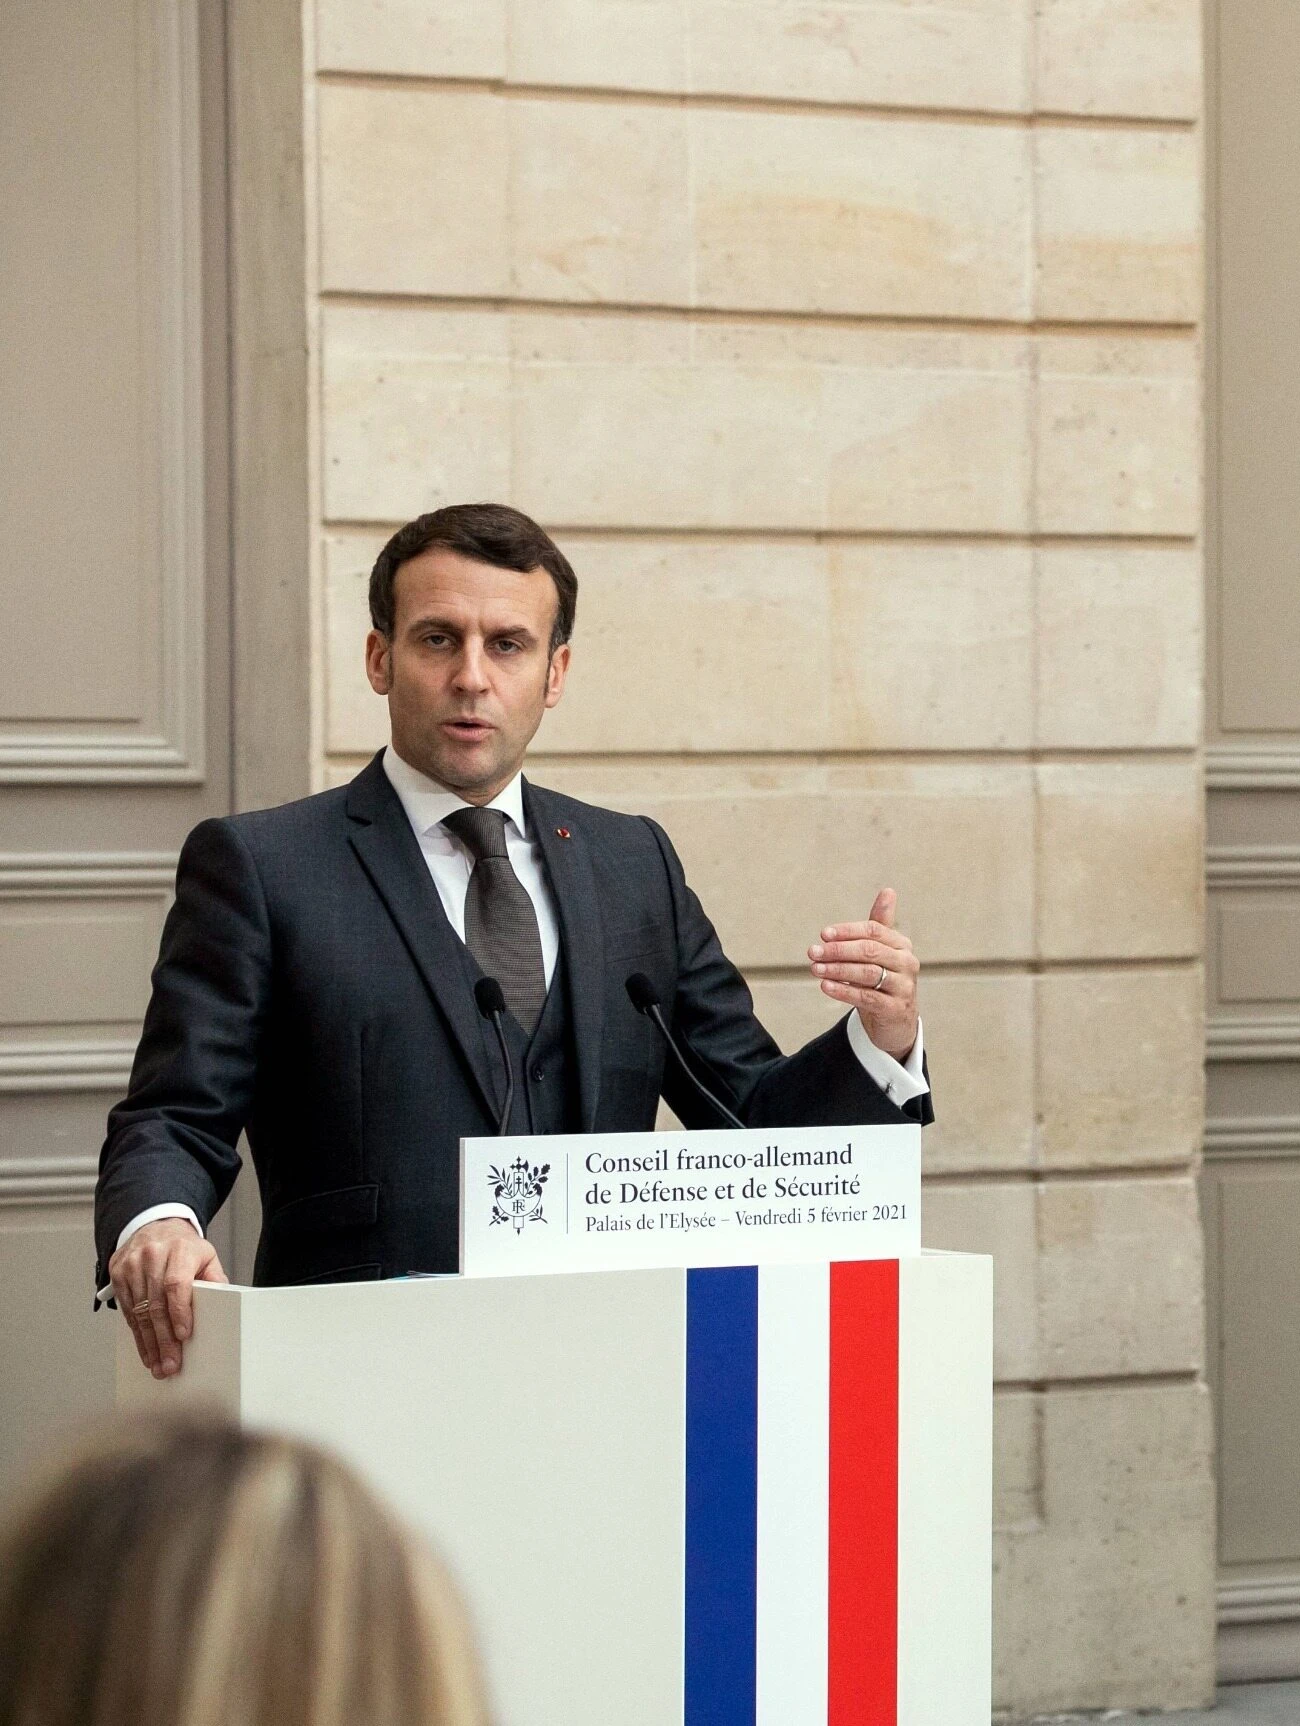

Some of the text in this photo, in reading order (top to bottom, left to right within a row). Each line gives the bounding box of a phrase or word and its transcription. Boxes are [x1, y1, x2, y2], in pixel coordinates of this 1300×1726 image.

[586, 1143, 852, 1173] Conseil franco-allemand
[586, 1174, 860, 1204] de Défense et de Sécurité
[586, 1215, 631, 1231] Palais
[637, 1214, 654, 1229] de
[660, 1212, 716, 1232] l'Elysée
[736, 1208, 801, 1225] Vendredi
[807, 1208, 816, 1223] 5
[822, 1206, 867, 1222] février
[872, 1204, 907, 1221] 2021
